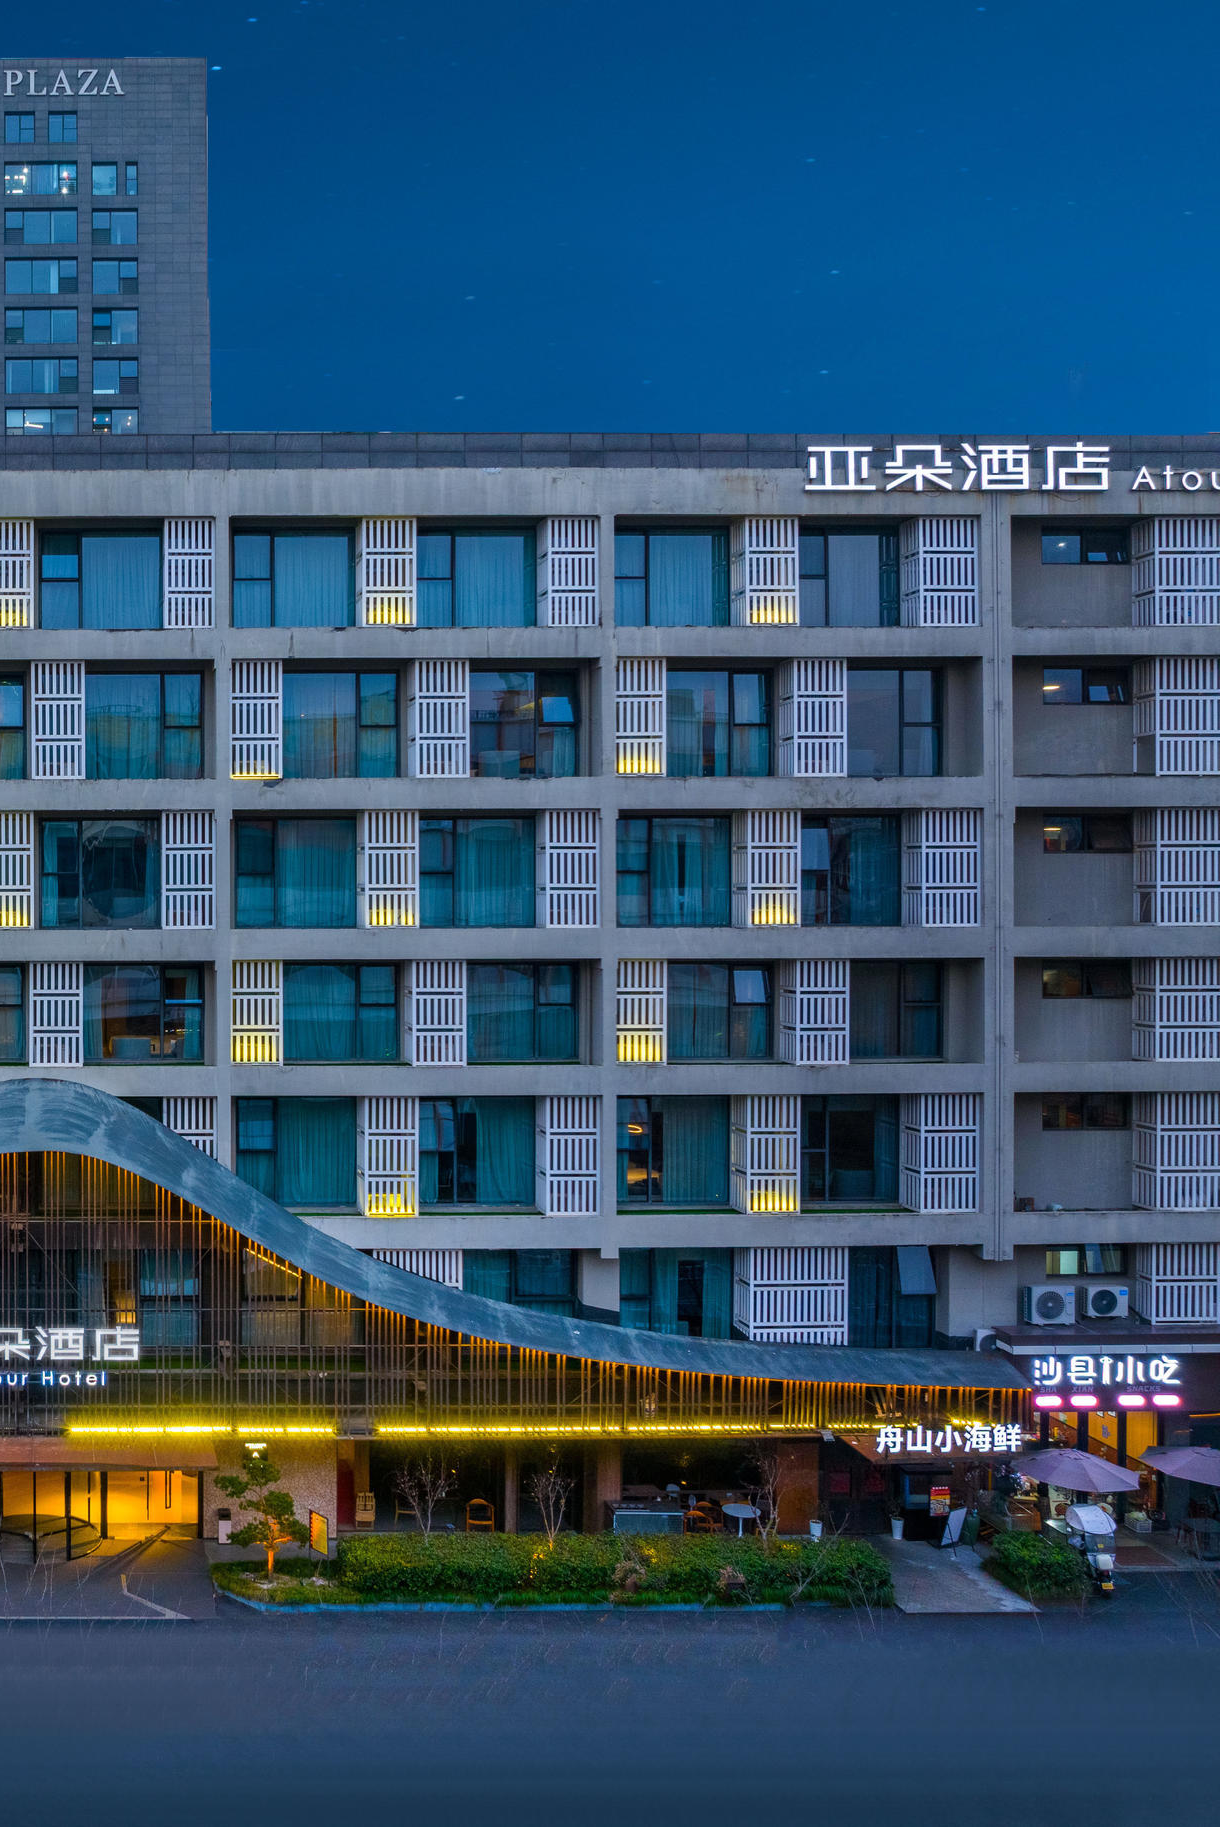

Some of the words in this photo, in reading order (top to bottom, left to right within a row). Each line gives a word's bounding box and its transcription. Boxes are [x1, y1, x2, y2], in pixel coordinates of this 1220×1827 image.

[3, 68, 125, 96] PLAZA
[804, 441, 1110, 492] 亚朵酒店
[42, 1370, 106, 1386] Hotel
[876, 1423, 1022, 1453] 舟山小海鲜
